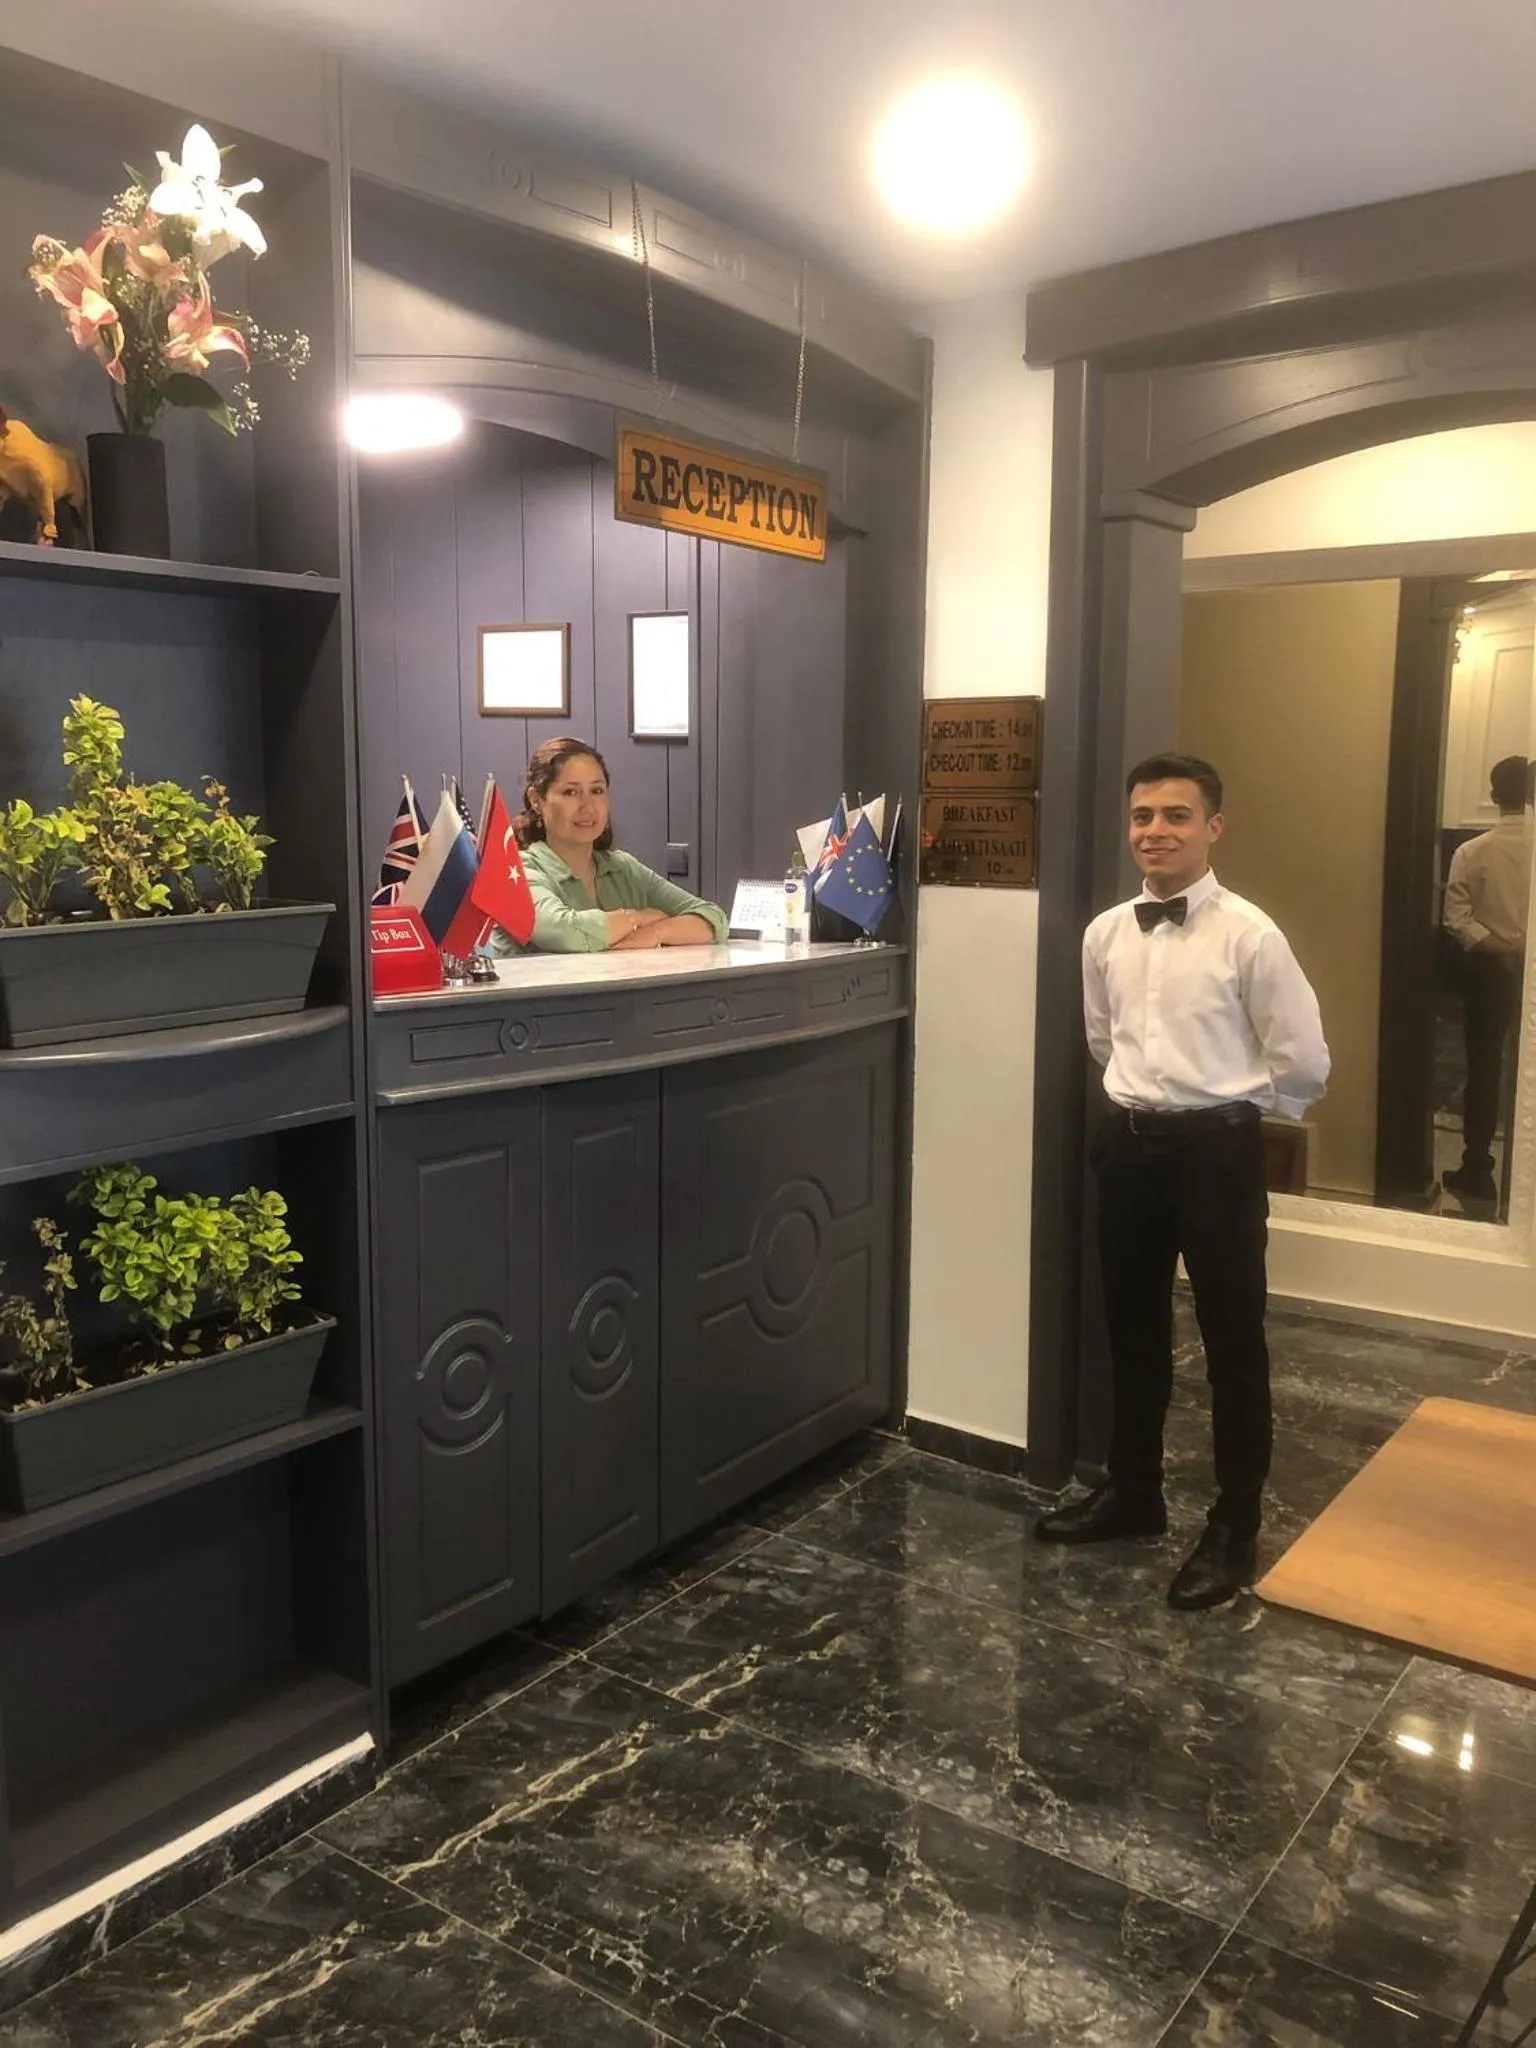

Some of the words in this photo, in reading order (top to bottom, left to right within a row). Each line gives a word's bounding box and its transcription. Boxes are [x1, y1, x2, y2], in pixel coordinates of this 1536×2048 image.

[632, 448, 818, 540] RECEPTION
[943, 805, 1016, 822] BREAKFAST
[371, 928, 390, 944] Tip
[389, 928, 412, 940] Box
